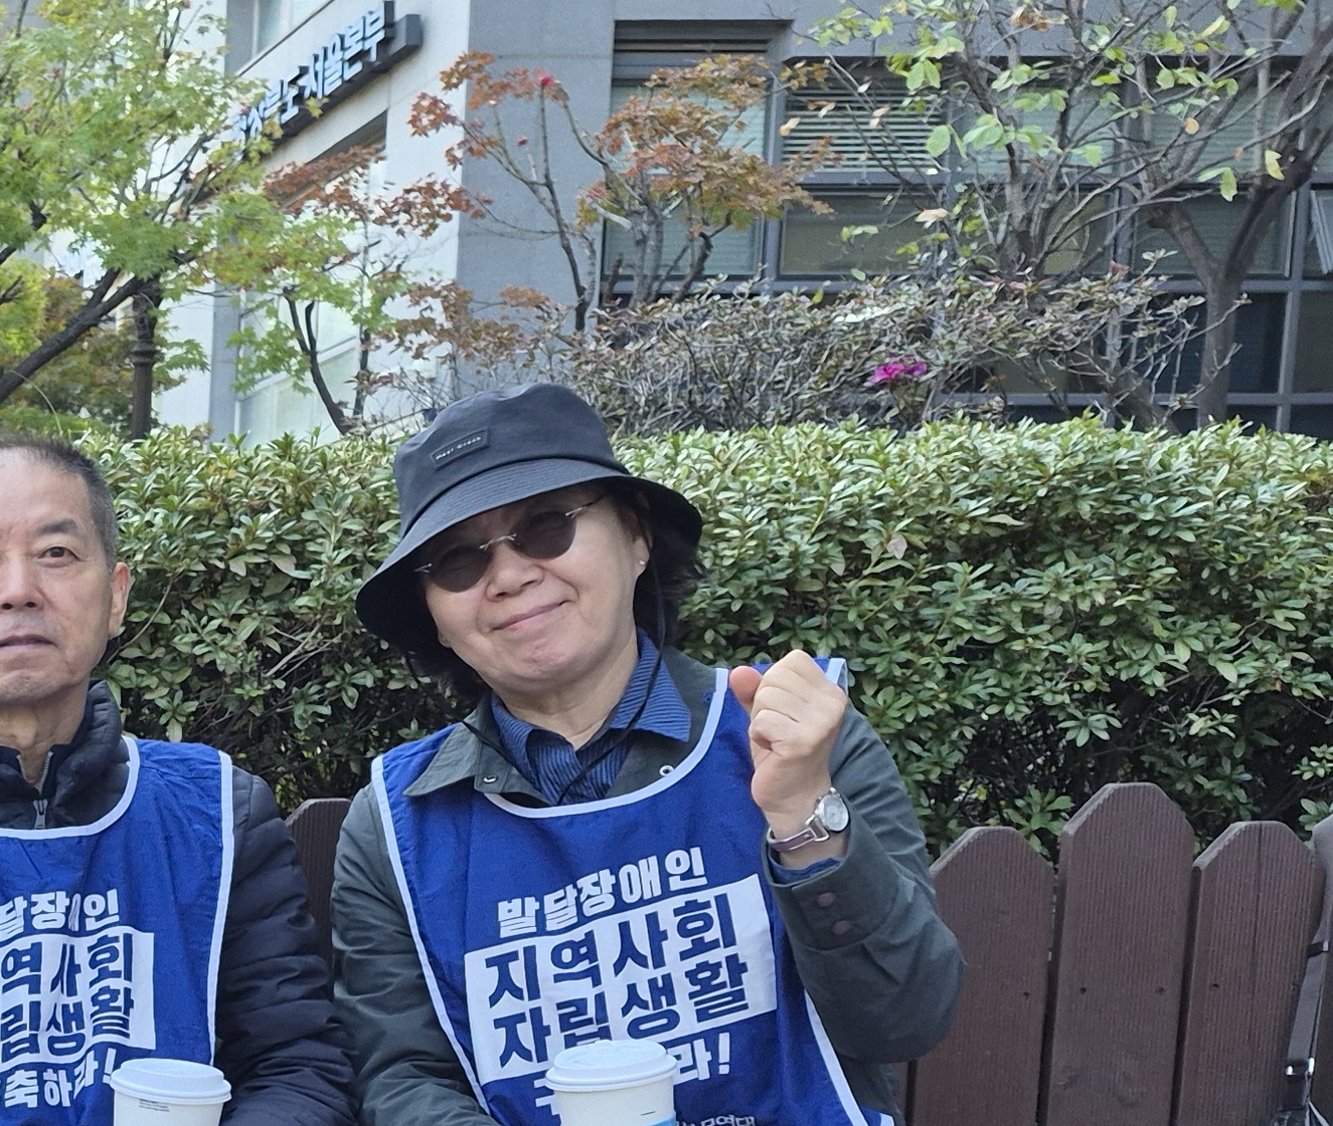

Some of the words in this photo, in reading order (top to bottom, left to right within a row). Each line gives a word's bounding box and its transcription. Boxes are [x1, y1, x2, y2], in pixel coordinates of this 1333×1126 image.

[496, 845, 707, 939] 발달장애인
[485, 893, 737, 1008] 지역사회
[493, 952, 749, 1068] 자립생활
